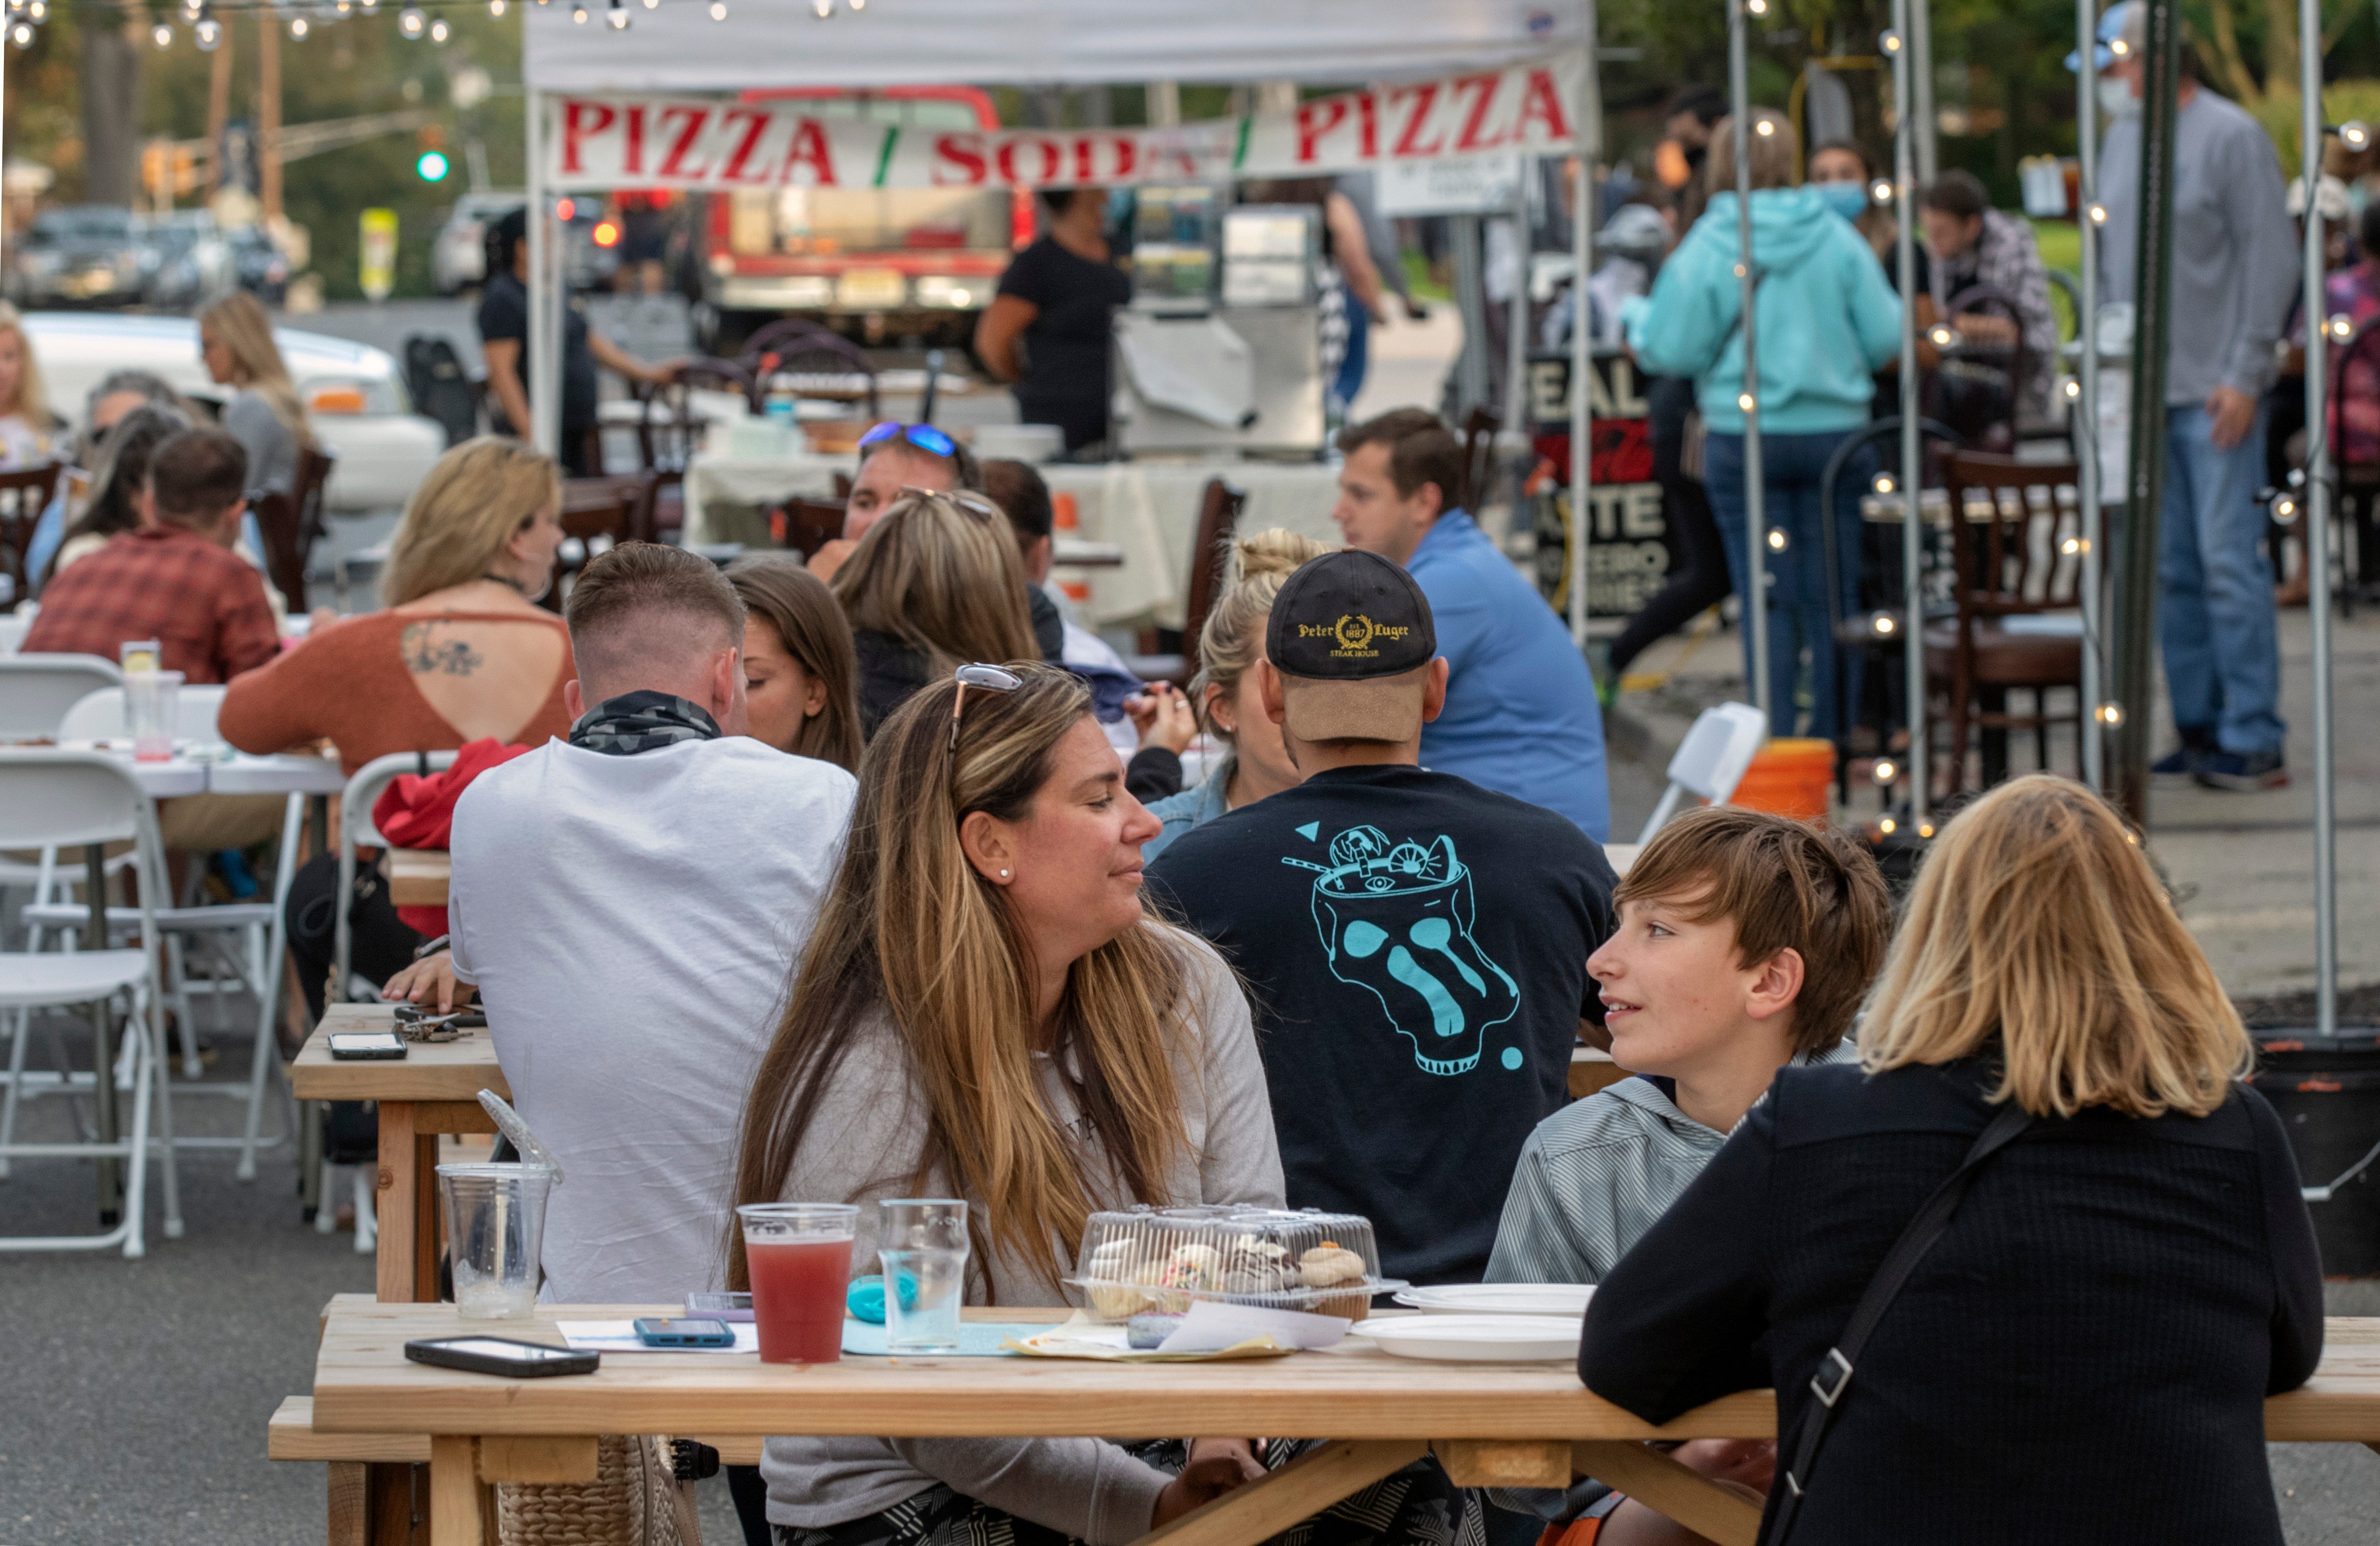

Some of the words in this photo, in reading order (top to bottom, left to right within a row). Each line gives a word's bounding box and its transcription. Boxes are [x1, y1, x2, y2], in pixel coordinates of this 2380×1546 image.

[560, 99, 838, 188] PIZZA
[1294, 67, 1574, 164] PIZZA
[1530, 359, 1650, 417] EAL
[1298, 624, 1334, 638] Peter
[1373, 623, 1409, 640] Luger
[1345, 629, 1365, 638] 1887
